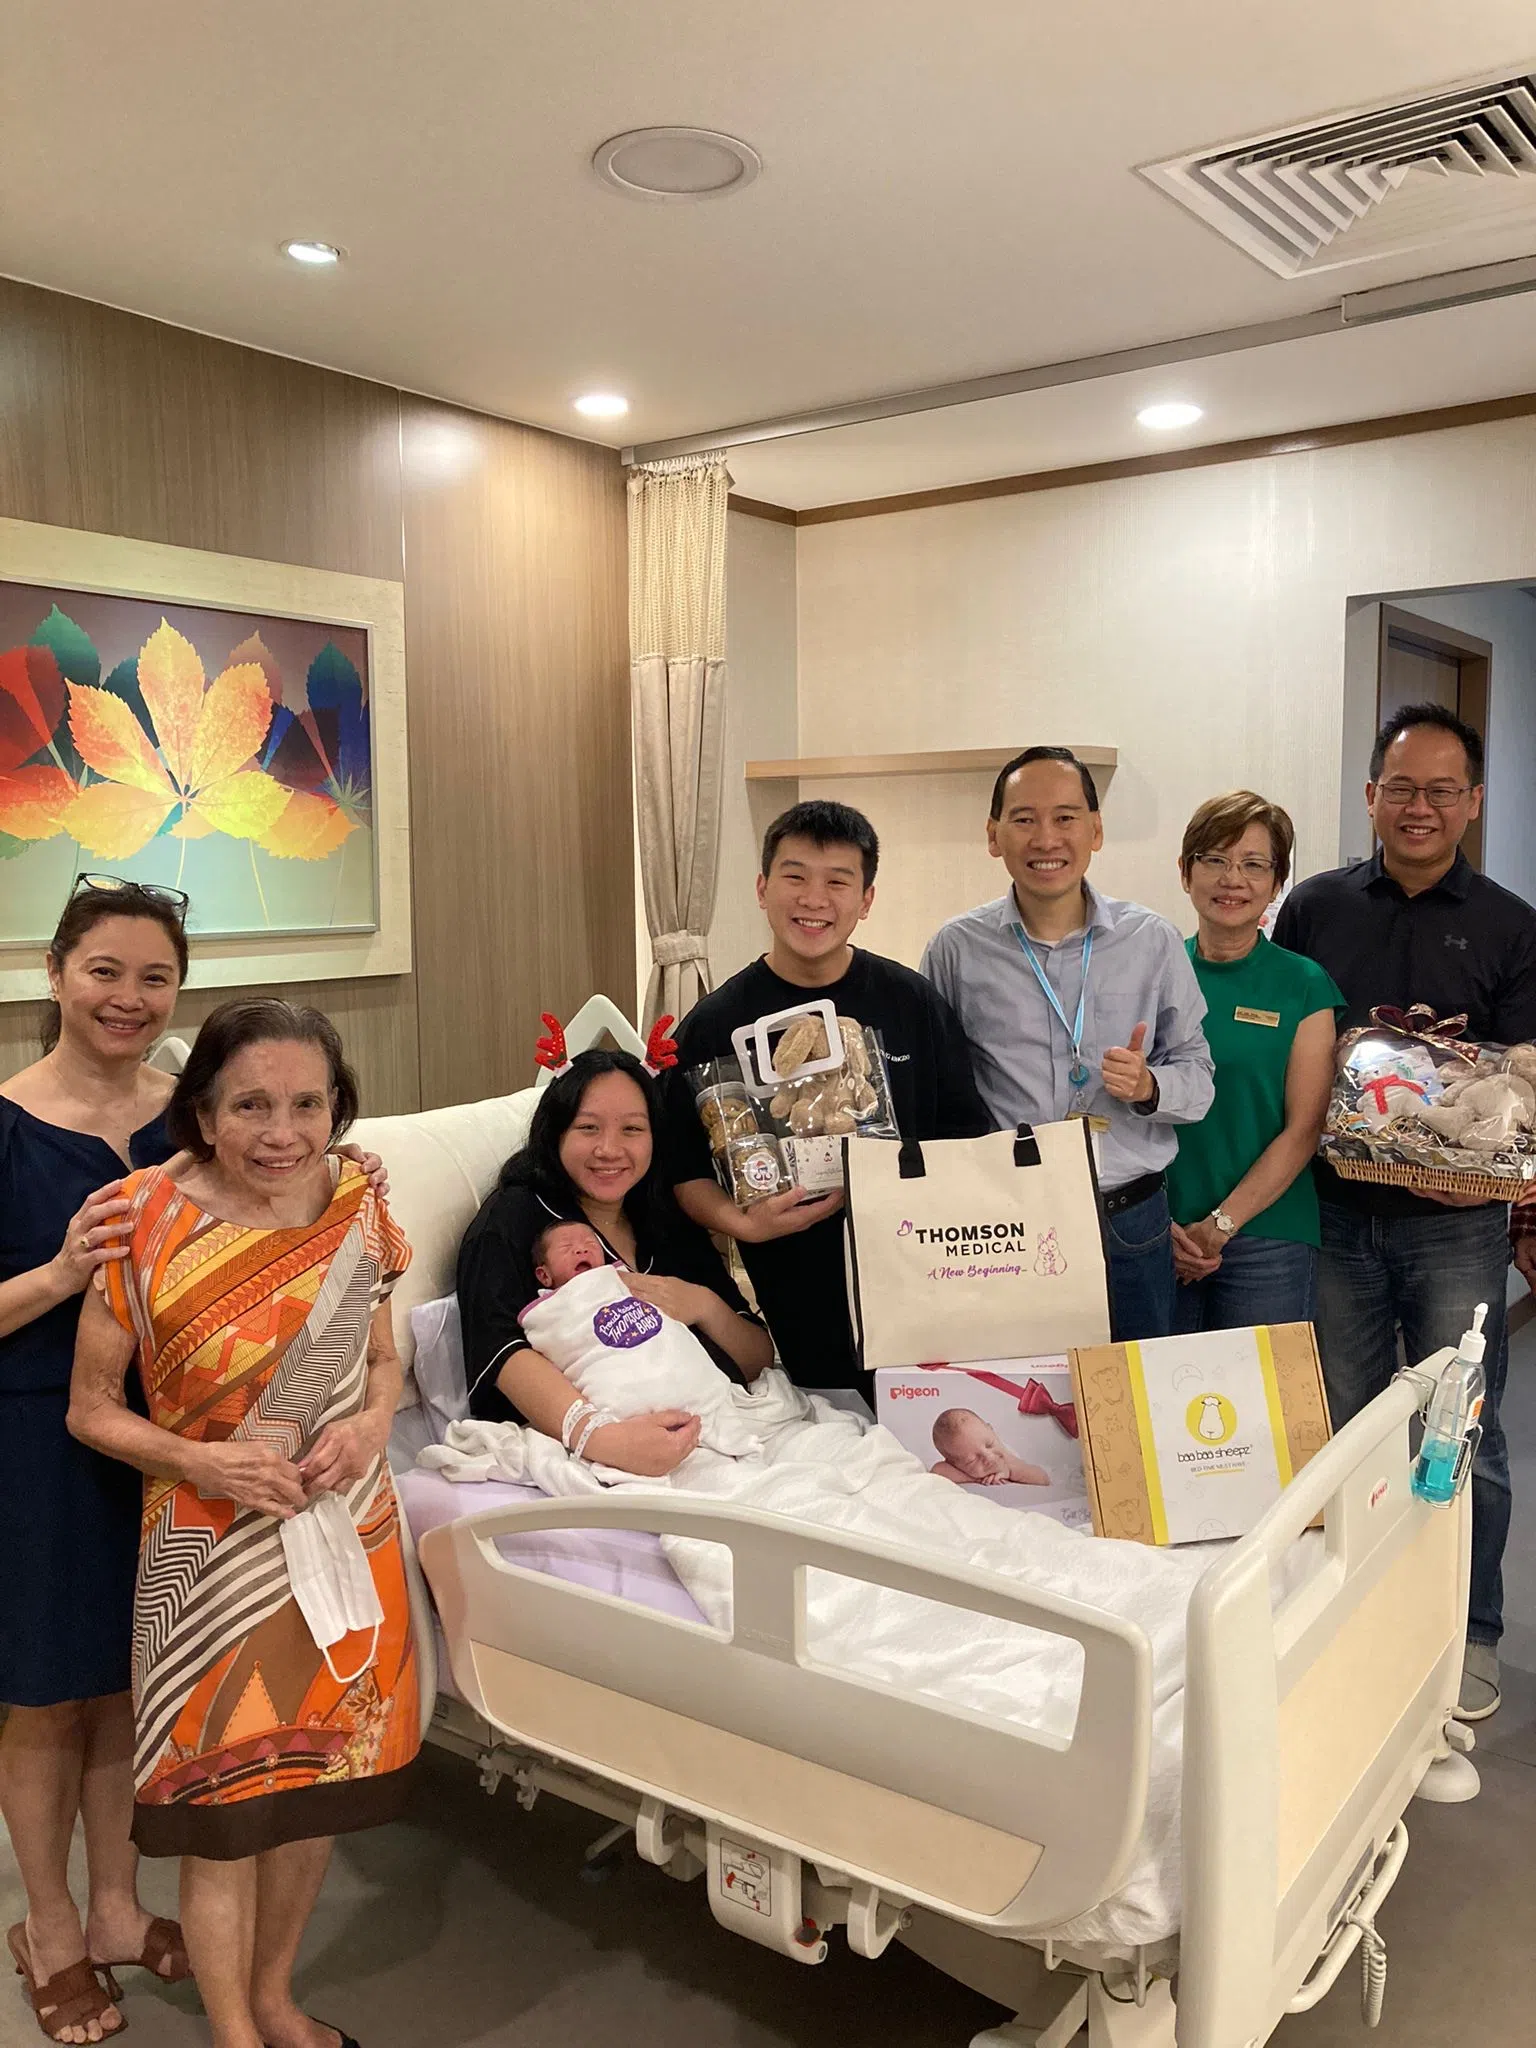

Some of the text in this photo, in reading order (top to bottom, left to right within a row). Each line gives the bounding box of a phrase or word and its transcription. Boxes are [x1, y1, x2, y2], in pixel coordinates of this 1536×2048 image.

[915, 1222, 1025, 1244] THOMSON
[946, 1240, 1026, 1257] MEDICAL
[927, 1268, 938, 1280] A
[940, 1266, 965, 1280] New
[600, 1310, 620, 1335] Proud
[608, 1305, 646, 1343] THOMSON
[635, 1313, 658, 1335] BABY
[890, 1385, 940, 1400] pigeon
[1177, 1452, 1196, 1463] baa
[1196, 1450, 1215, 1461] baa
